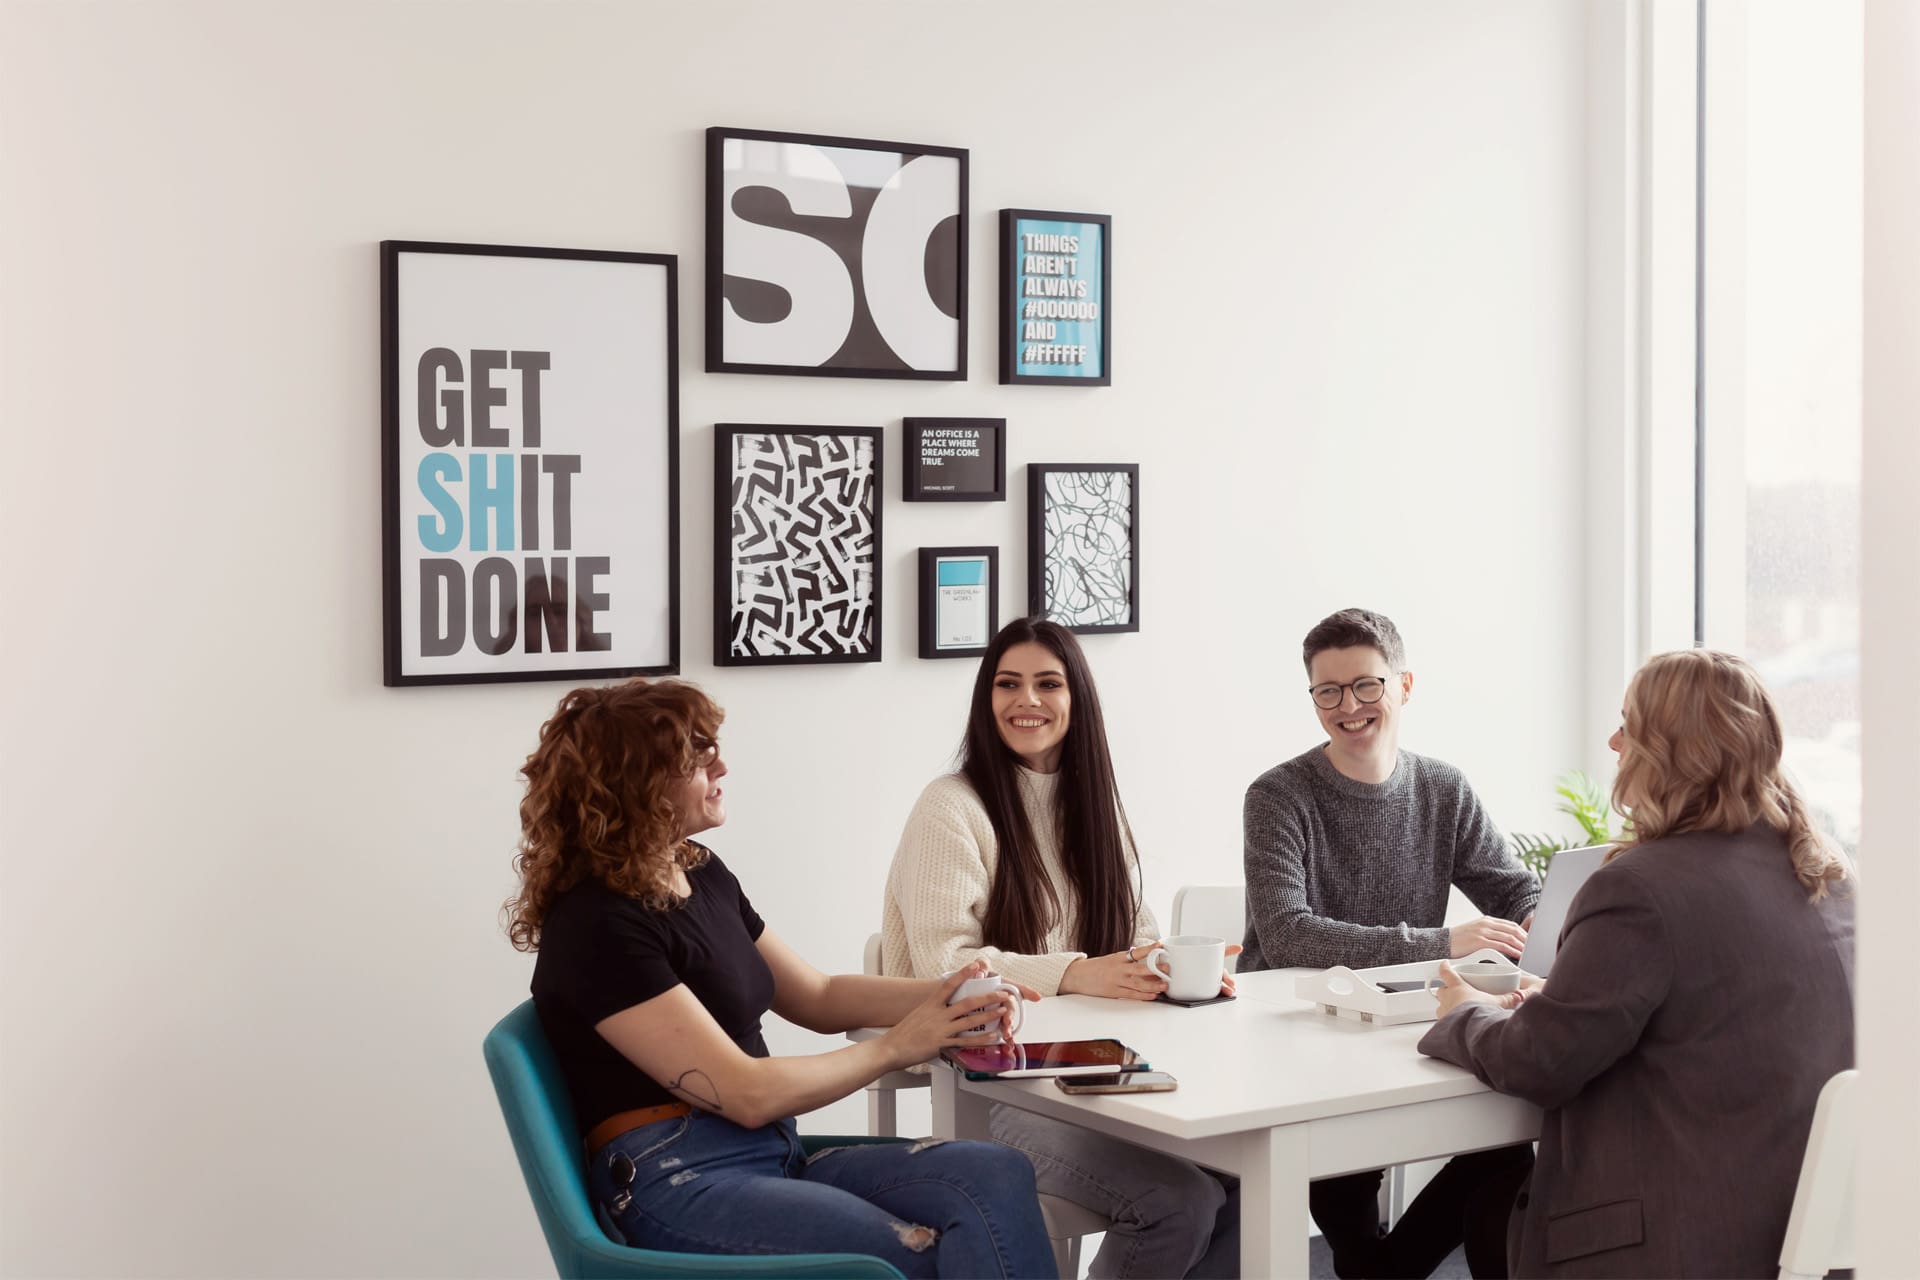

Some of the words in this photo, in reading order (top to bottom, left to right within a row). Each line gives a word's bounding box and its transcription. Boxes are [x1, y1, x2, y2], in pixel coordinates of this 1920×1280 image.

[1024, 233, 1079, 253] THINGS
[1024, 256, 1078, 275] AREN'T
[1024, 278, 1088, 297] ALWAYS
[1024, 322, 1057, 340] AND
[1024, 344, 1088, 363] #FFFFFF
[417, 347, 551, 448] GET
[921, 429, 934, 438] AN
[935, 430, 963, 438] OFFICE
[964, 430, 972, 438] IS
[973, 430, 980, 438] A
[921, 439, 947, 447] PLACE
[948, 439, 977, 448] WHERE
[921, 448, 955, 456] DREAMS
[956, 448, 980, 457] COME
[921, 457, 945, 466] TRUE.
[417, 452, 582, 553] SHIT
[419, 556, 612, 657] DONE
